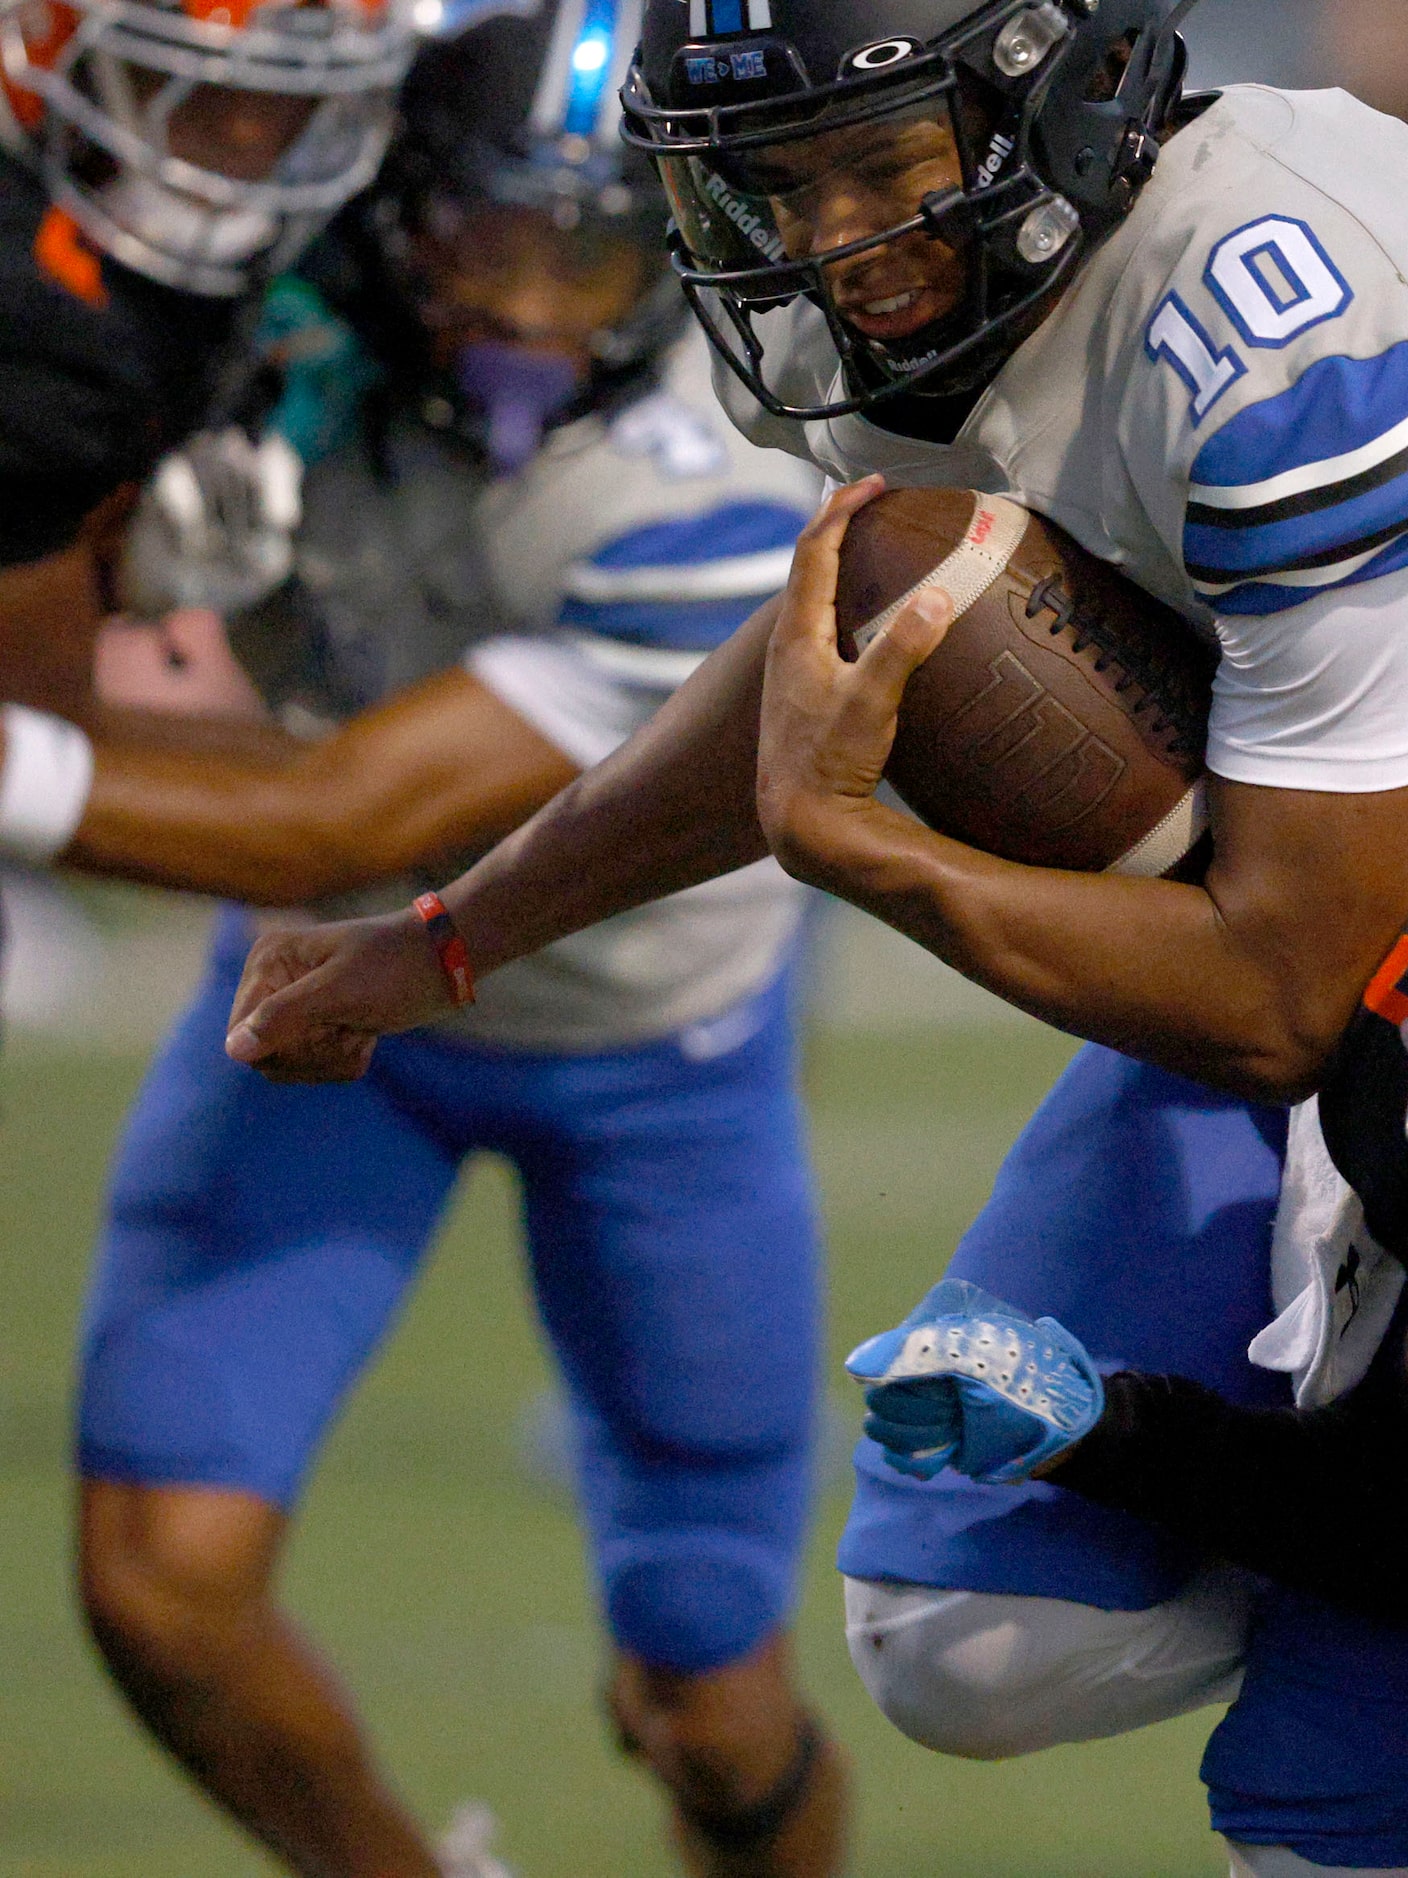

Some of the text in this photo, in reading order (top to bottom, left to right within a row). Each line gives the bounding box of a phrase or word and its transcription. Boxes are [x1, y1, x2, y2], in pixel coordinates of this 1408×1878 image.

[975, 133, 1015, 189] dell
[705, 172, 787, 262] Riddell
[1143, 213, 1354, 427] 10
